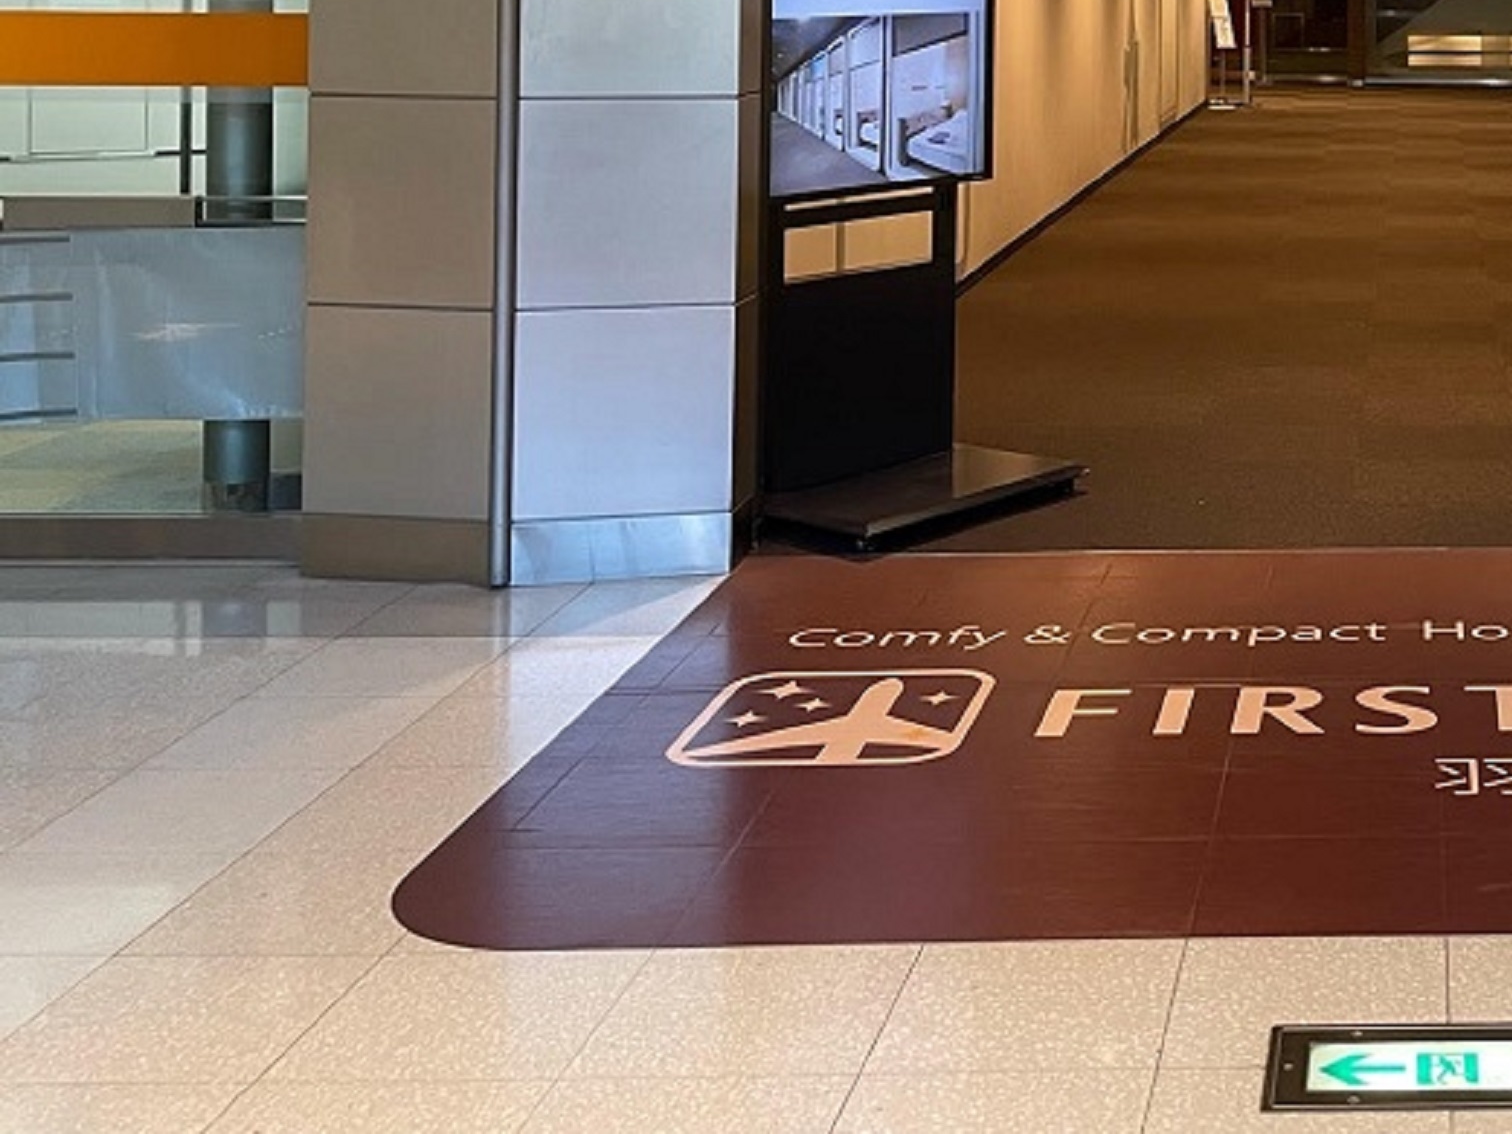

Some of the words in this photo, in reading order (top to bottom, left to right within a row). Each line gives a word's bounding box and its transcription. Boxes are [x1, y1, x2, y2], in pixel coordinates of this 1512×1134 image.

[788, 624, 1006, 650] Comfy
[1023, 624, 1072, 644] &
[1091, 621, 1388, 647] Compact
